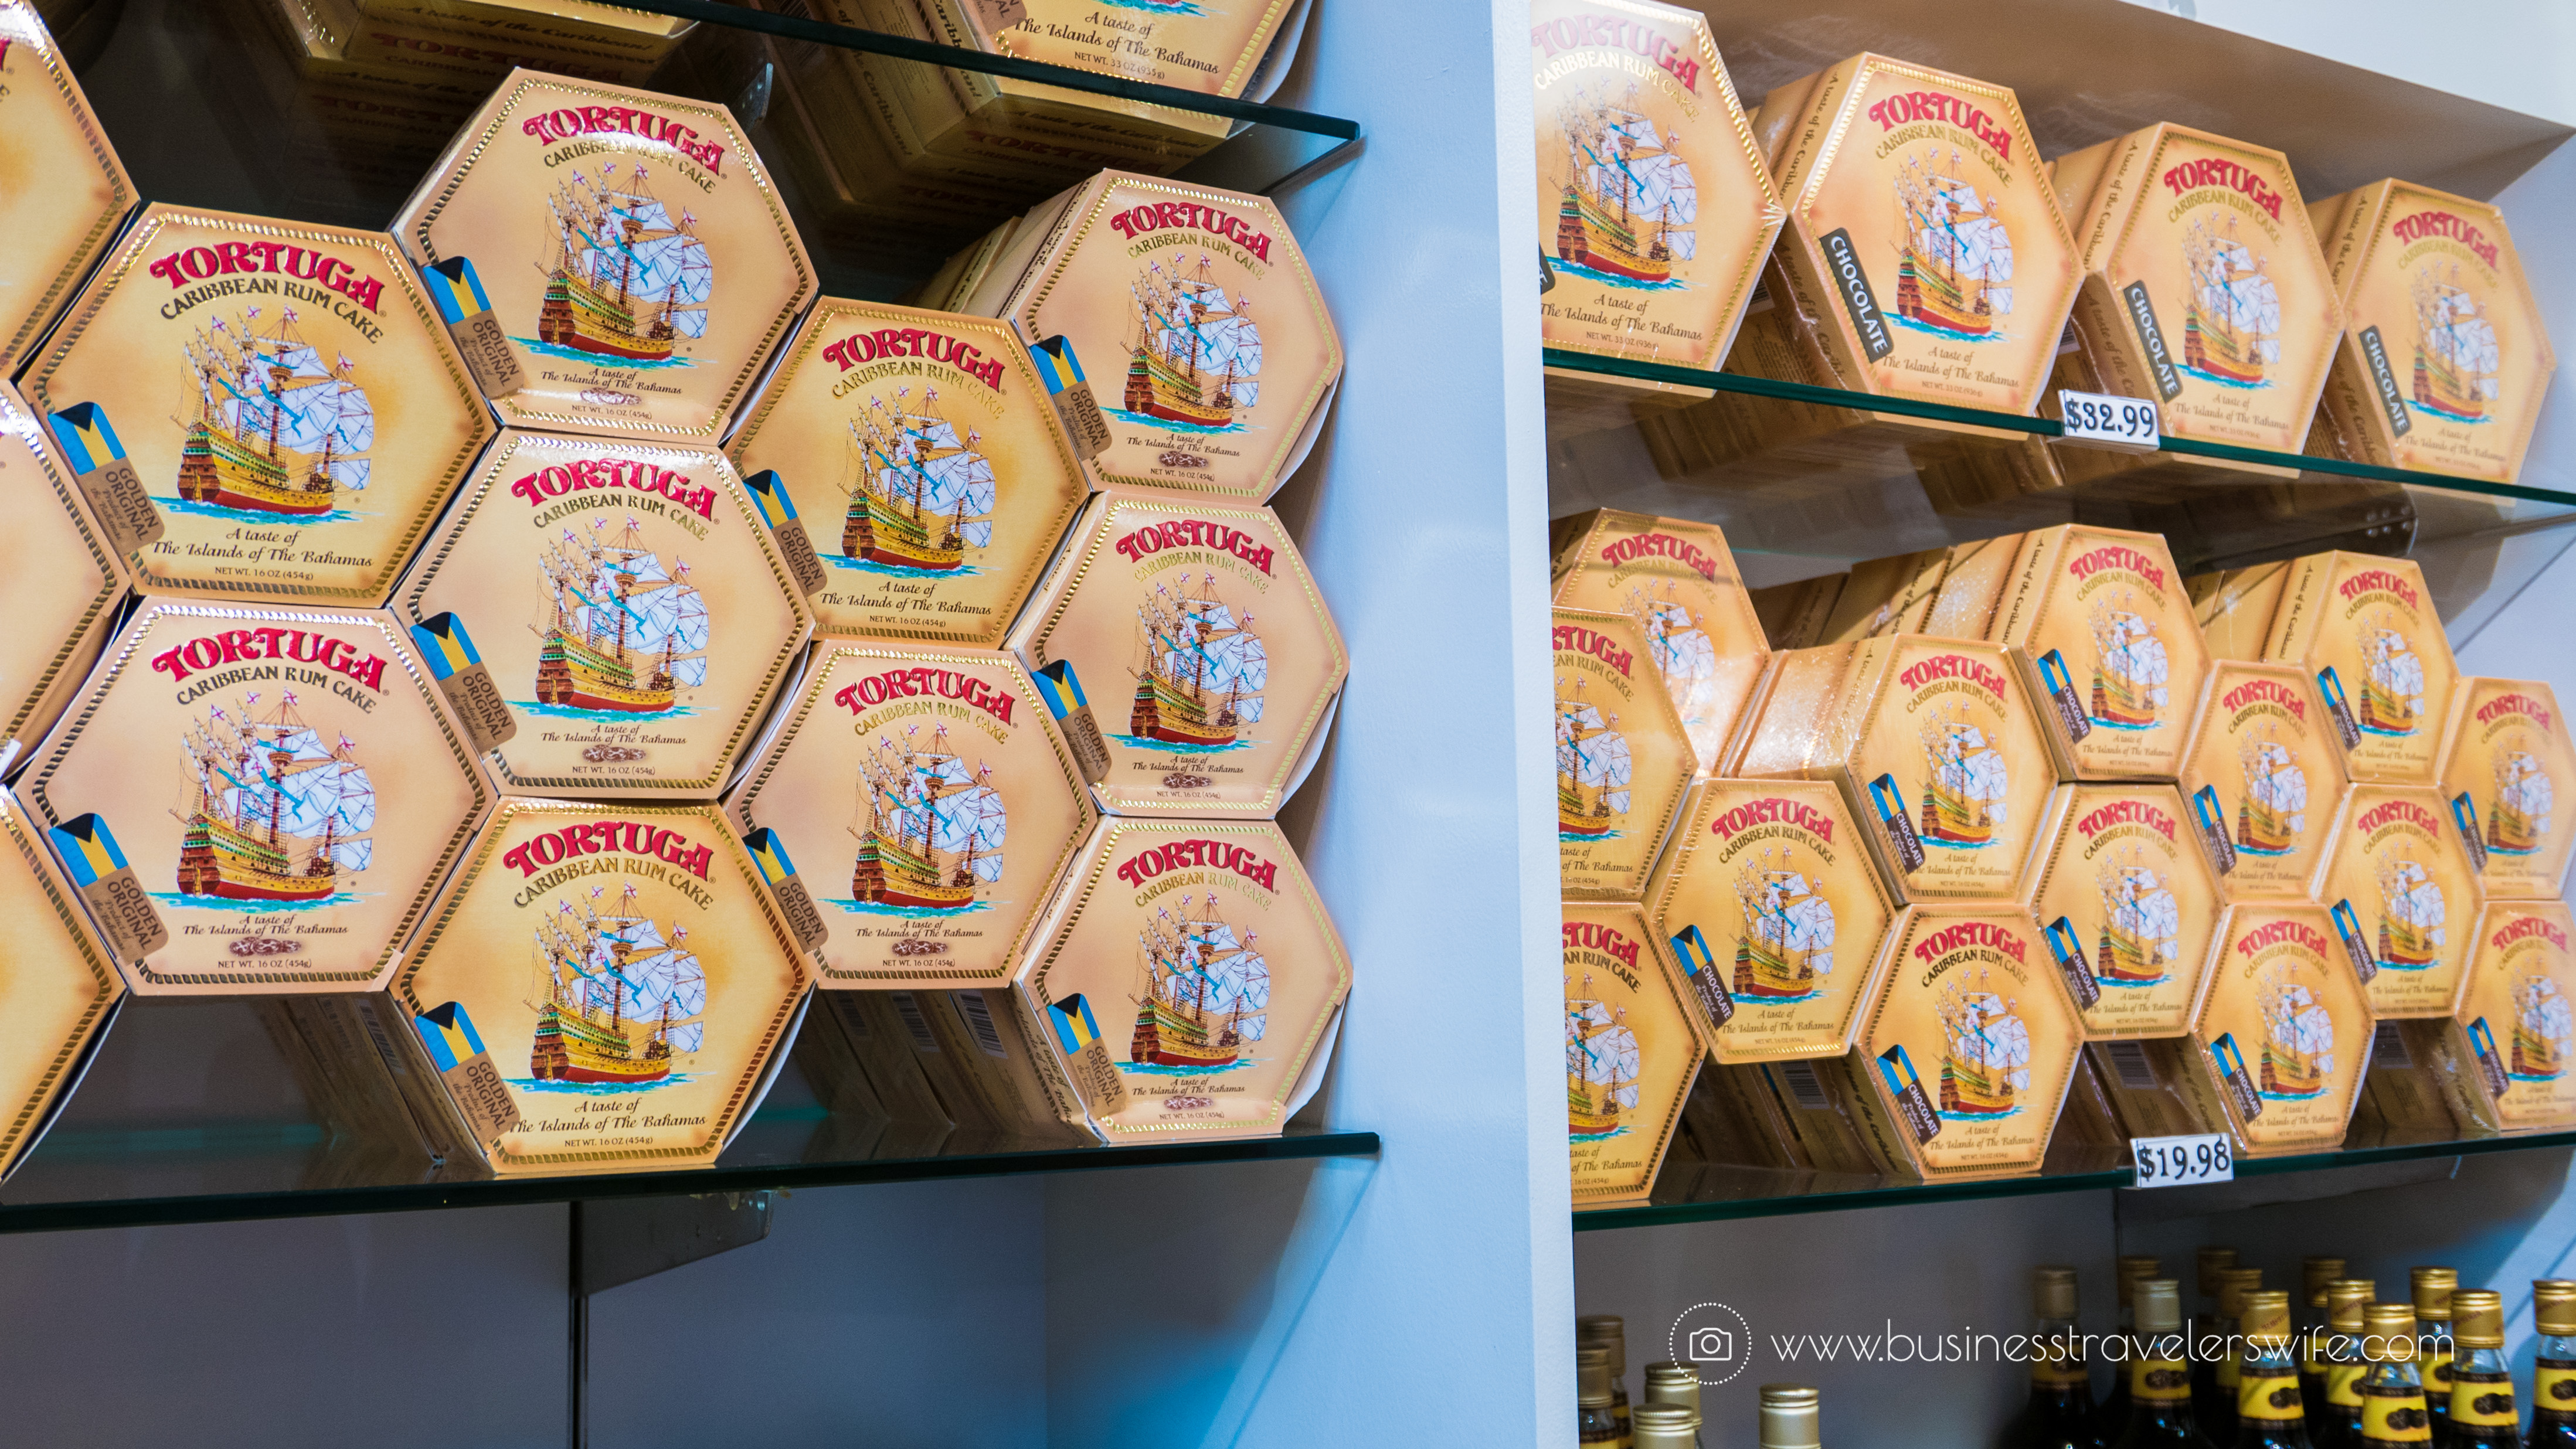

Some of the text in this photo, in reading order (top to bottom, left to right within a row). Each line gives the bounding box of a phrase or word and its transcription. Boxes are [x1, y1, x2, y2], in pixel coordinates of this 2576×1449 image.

[1015, 18, 1220, 74] The Islands of The Bahamas
[1085, 12, 1155, 39] A taste of
[1075, 51, 1092, 62] NET
[1110, 59, 1122, 69] 33
[1123, 62, 1136, 72] OZ
[1532, 13, 1701, 95] TORTUGA
[1533, 50, 1700, 123] CARIBBEAN RUM CAKE
[522, 106, 725, 175] TORTUGA
[1869, 91, 2011, 161] TORTUGA
[2164, 158, 2280, 222] TORTUGA
[1110, 202, 1272, 263] TORTUGA
[1127, 234, 1265, 280] CARIBBEAN RUM CAKE
[2393, 211, 2496, 267] TORTUGA
[149, 241, 383, 314] TORTUGA
[1831, 236, 1888, 353] CHOCOLATE
[161, 278, 383, 344] CARIBBEAN RUM CAKE
[473, 323, 509, 387] ORIGINAL
[485, 320, 519, 375] GOLDEN
[823, 328, 1004, 391] TORTUGA
[2132, 287, 2178, 394] CHOCOLATE
[831, 362, 1004, 419] CARIBBEAN RUM CAKE
[2366, 332, 2407, 430] CHOCOLATE
[1070, 392, 1100, 450] ORIGINAL
[1081, 390, 1108, 439] GOLDEN
[2066, 398, 2155, 438] $32.99
[106, 472, 148, 541] ORIGINAL
[120, 468, 158, 528] GOLDEN
[511, 458, 717, 521] TORTUGA
[226, 528, 301, 546] A taste of
[533, 495, 709, 541] CARIBBEAN RUM CAKE
[150, 541, 374, 566] The Islands of The Bahamas
[215, 567, 232, 575] NET
[283, 571, 313, 580] (454g)
[1116, 520, 1274, 576] TORTUGA
[1602, 533, 1717, 581] TORTUGA
[2069, 546, 2163, 590] TORTUGA
[821, 593, 993, 615] The Islands of The Bahamas
[879, 581, 937, 598] A taste of
[2340, 570, 2417, 609] TORTUGA
[152, 627, 386, 692] TORTUGA
[1900, 654, 2005, 700] TORTUGA
[176, 666, 376, 714] CARIBBEAN RUM CAKE
[835, 668, 1015, 724] TORTUGA
[2223, 680, 2305, 720] TORTUGA
[2477, 694, 2548, 728] TORTUGA
[541, 732, 688, 744] The Islands of The Bahamas
[605, 725, 627, 733] taste
[630, 725, 641, 736] of
[1074, 717, 1102, 773] ORIGINAL
[1083, 714, 1108, 763] GOLDEN
[1711, 798, 1833, 842] TORTUGA
[1897, 813, 1923, 866] CHOCOLATE
[2078, 800, 2174, 841] TORTUGA
[2358, 801, 2438, 836] TORTUGA
[503, 821, 712, 881] TORTUGA
[1117, 839, 1277, 892] TORTUGA
[1719, 826, 1836, 866] CARIBBEAN RUM CAKE
[121, 877, 162, 936] GOLDEN
[514, 858, 713, 911] CARIBBEAN RUM CAKE
[1134, 873, 1274, 911] CARIBBEAN RUM CAKE
[108, 882, 151, 950] ORIGINAL
[2238, 921, 2327, 958] TORTUGA
[2493, 917, 2564, 950] TORTUGA
[286, 959, 312, 968] (454g)
[1914, 922, 2026, 964] TORTUGA
[1923, 950, 2028, 987] CARIBBEAN RUM CAKE
[1702, 965, 1732, 1019] CHOCOLATE
[479, 1062, 515, 1117] GOLDEN
[1086, 1050, 1114, 1107] ORIGINAL
[1096, 1046, 1122, 1096] GOLDEN
[467, 1066, 505, 1130] ORIGINAL
[1908, 1084, 1939, 1136] CHOCOLATE
[2139, 1135, 2230, 1182] $19.98
